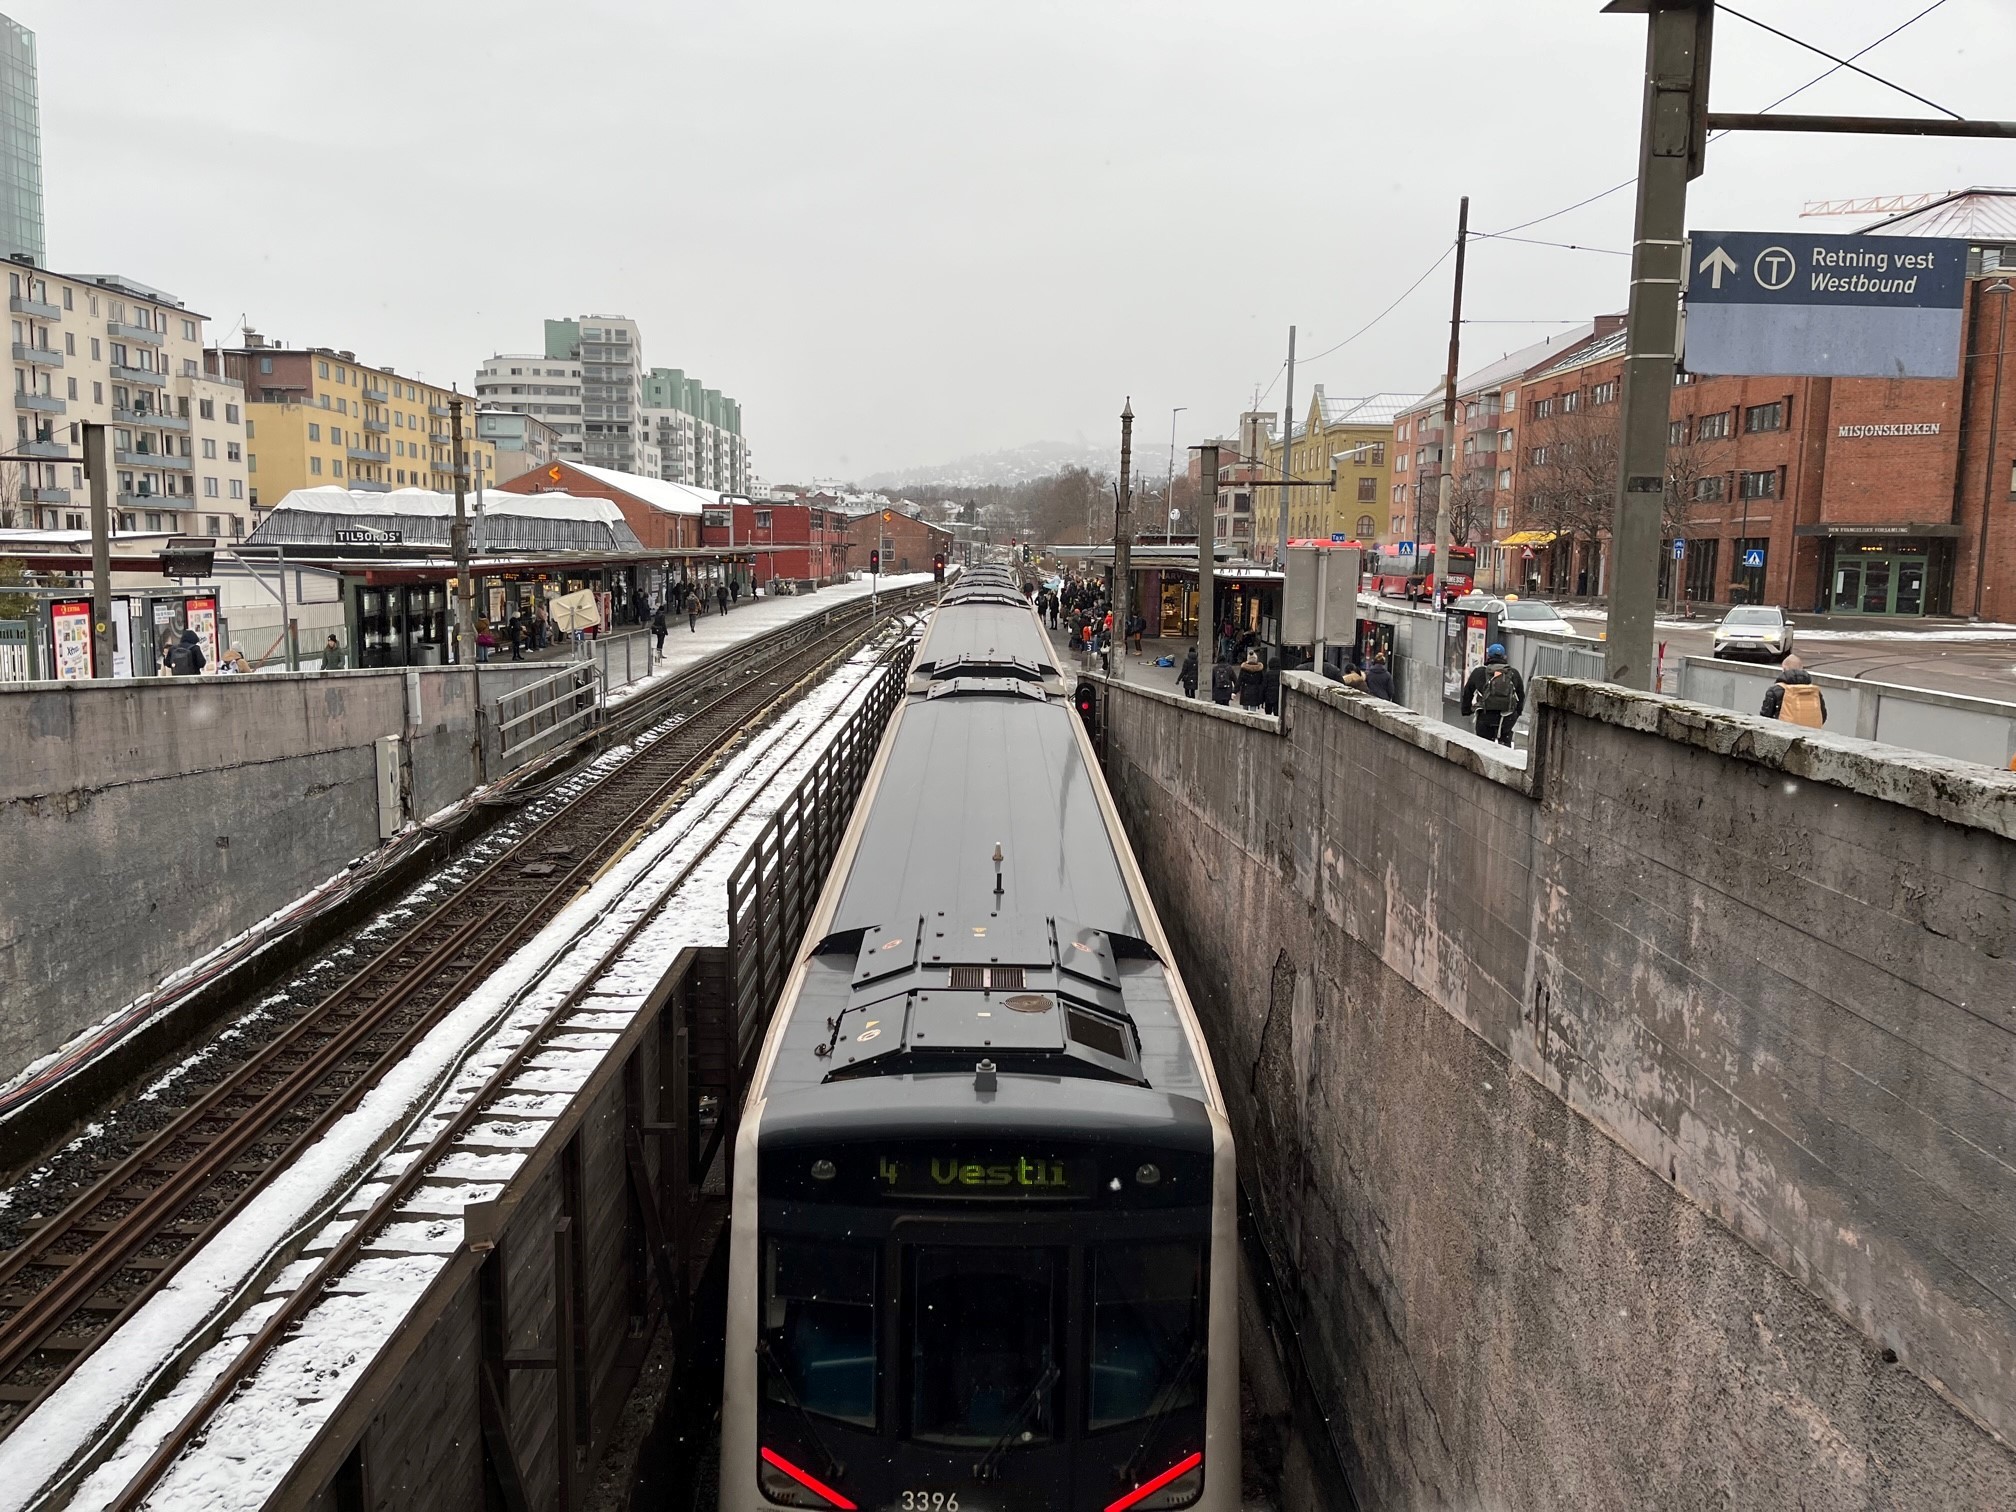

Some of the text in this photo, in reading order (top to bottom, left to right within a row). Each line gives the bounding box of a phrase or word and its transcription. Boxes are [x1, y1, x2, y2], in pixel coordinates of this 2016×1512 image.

[1812, 247, 1935, 272] Retning vest
[1811, 273, 1917, 294] Westbound
[1838, 423, 1941, 439] MISJONSKIRKEN
[1086, 644, 1092, 652] 3
[879, 1155, 1066, 1186] 4 Vestli
[901, 1490, 960, 1512] 3396
